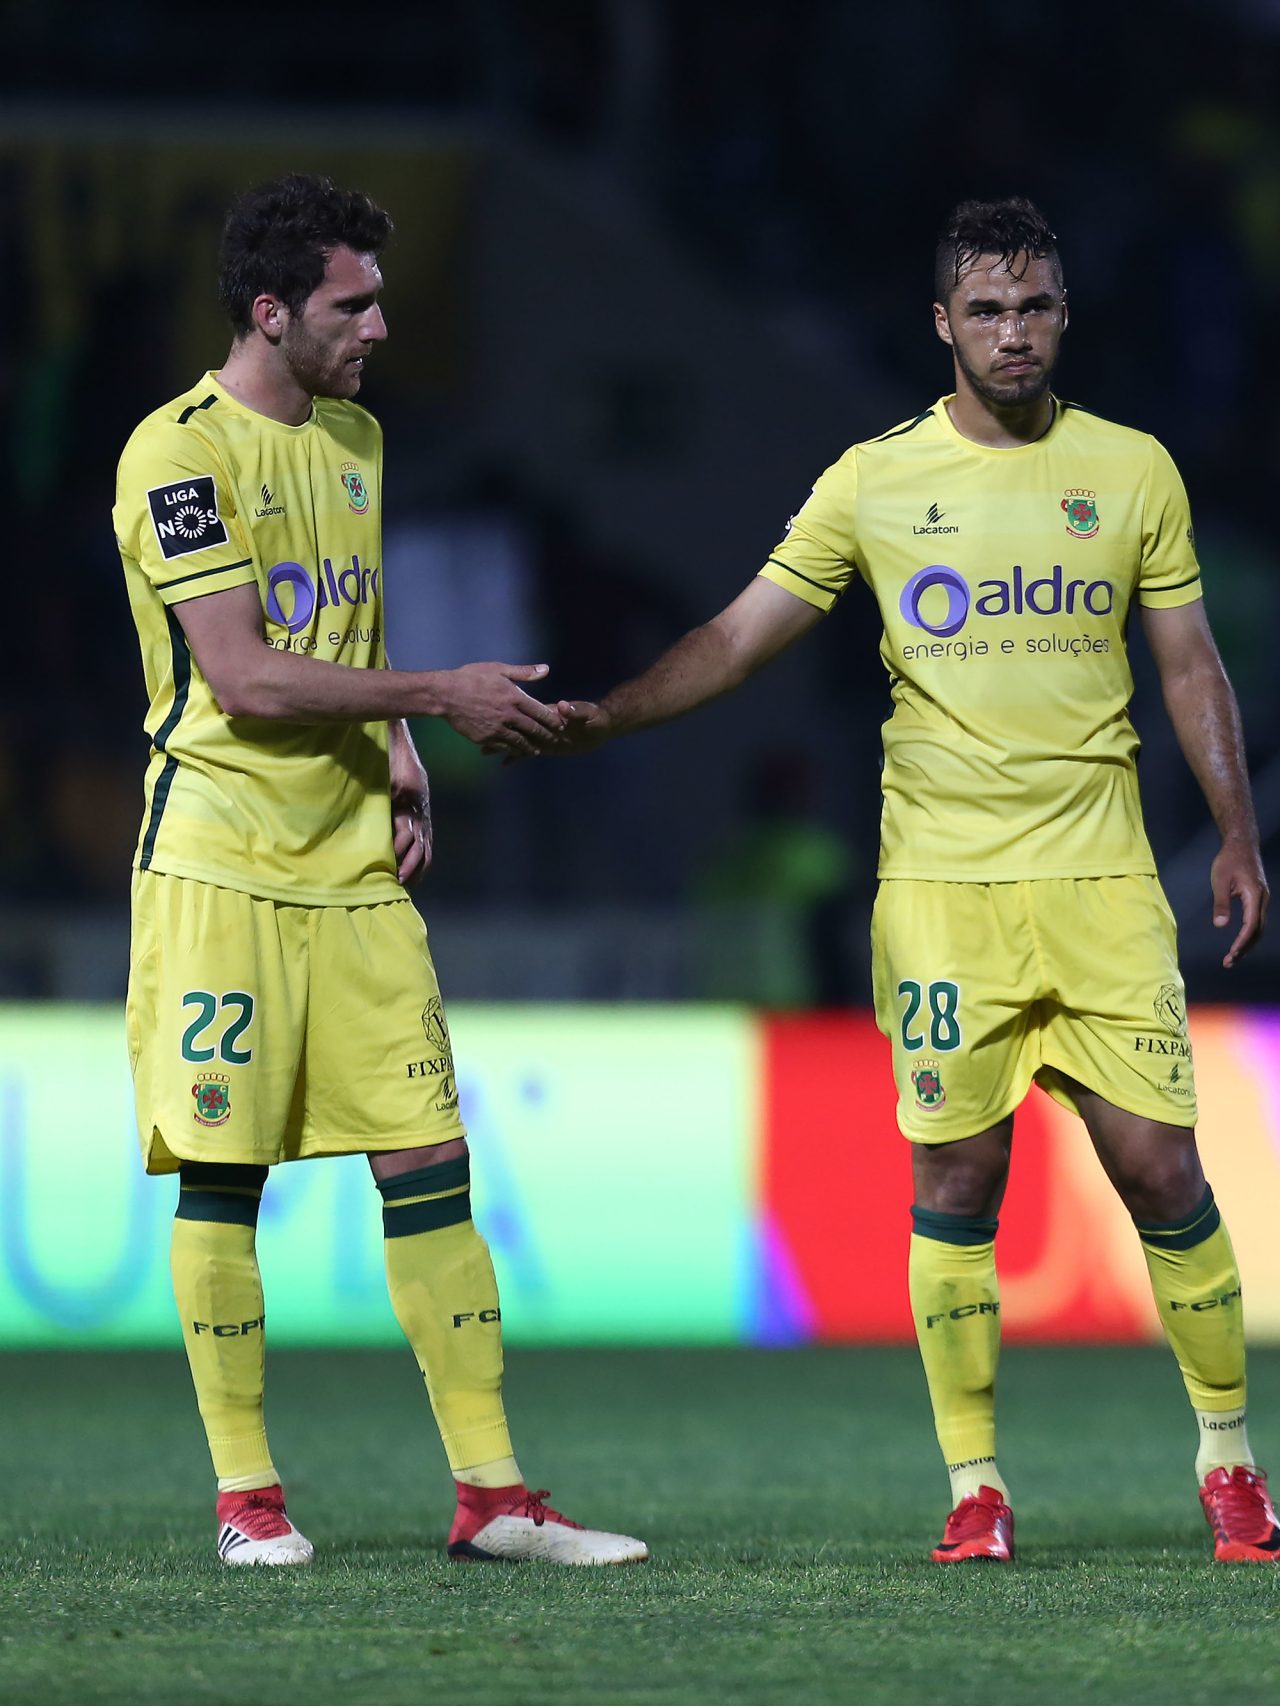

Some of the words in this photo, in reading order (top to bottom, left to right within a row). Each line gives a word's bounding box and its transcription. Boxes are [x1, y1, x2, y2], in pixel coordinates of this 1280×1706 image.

[164, 488, 199, 506] LIGA
[158, 506, 219, 539] NOS
[913, 525, 959, 535] Lacatoni
[975, 565, 1113, 616] aldro
[328, 632, 341, 645] e
[903, 636, 989, 661] energia
[1000, 639, 1015, 653] e
[1026, 633, 1109, 657] soluções
[181, 991, 255, 1065] 22
[897, 979, 961, 1053] 28
